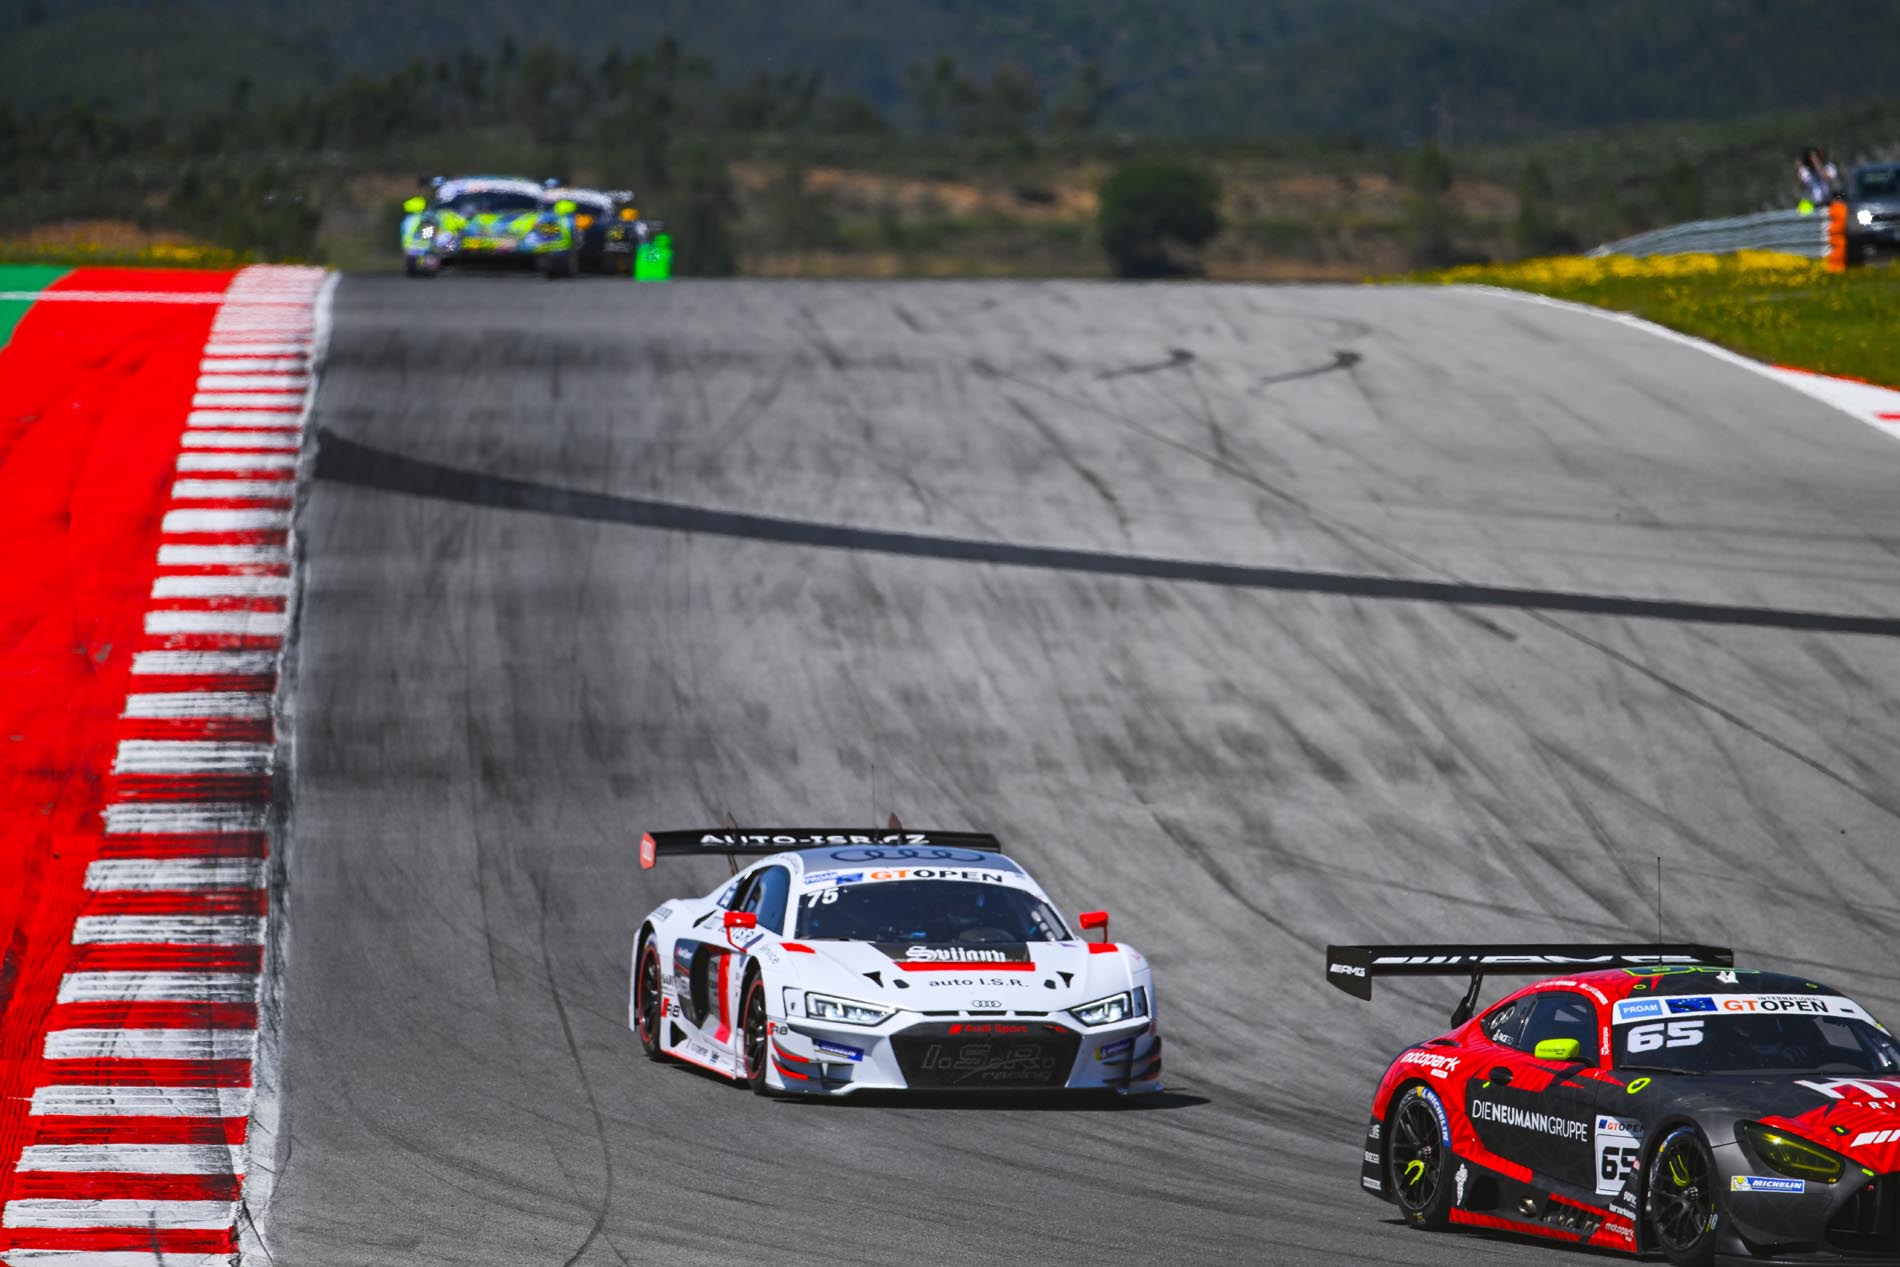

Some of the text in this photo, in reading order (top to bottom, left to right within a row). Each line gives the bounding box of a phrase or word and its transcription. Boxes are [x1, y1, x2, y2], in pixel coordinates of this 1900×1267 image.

[807, 887, 840, 908] 75
[929, 978, 973, 987] auto
[1622, 1003, 1659, 1016] PROAM
[965, 1023, 1028, 1034] Audi Sport
[1626, 1019, 1705, 1053] 65
[1400, 1051, 1461, 1072] motopark
[1426, 1091, 1449, 1141] MICHELIN
[1472, 1098, 1589, 1143] DIENEUMANNGRUPPE
[1752, 1179, 1803, 1189] MICHELIN
